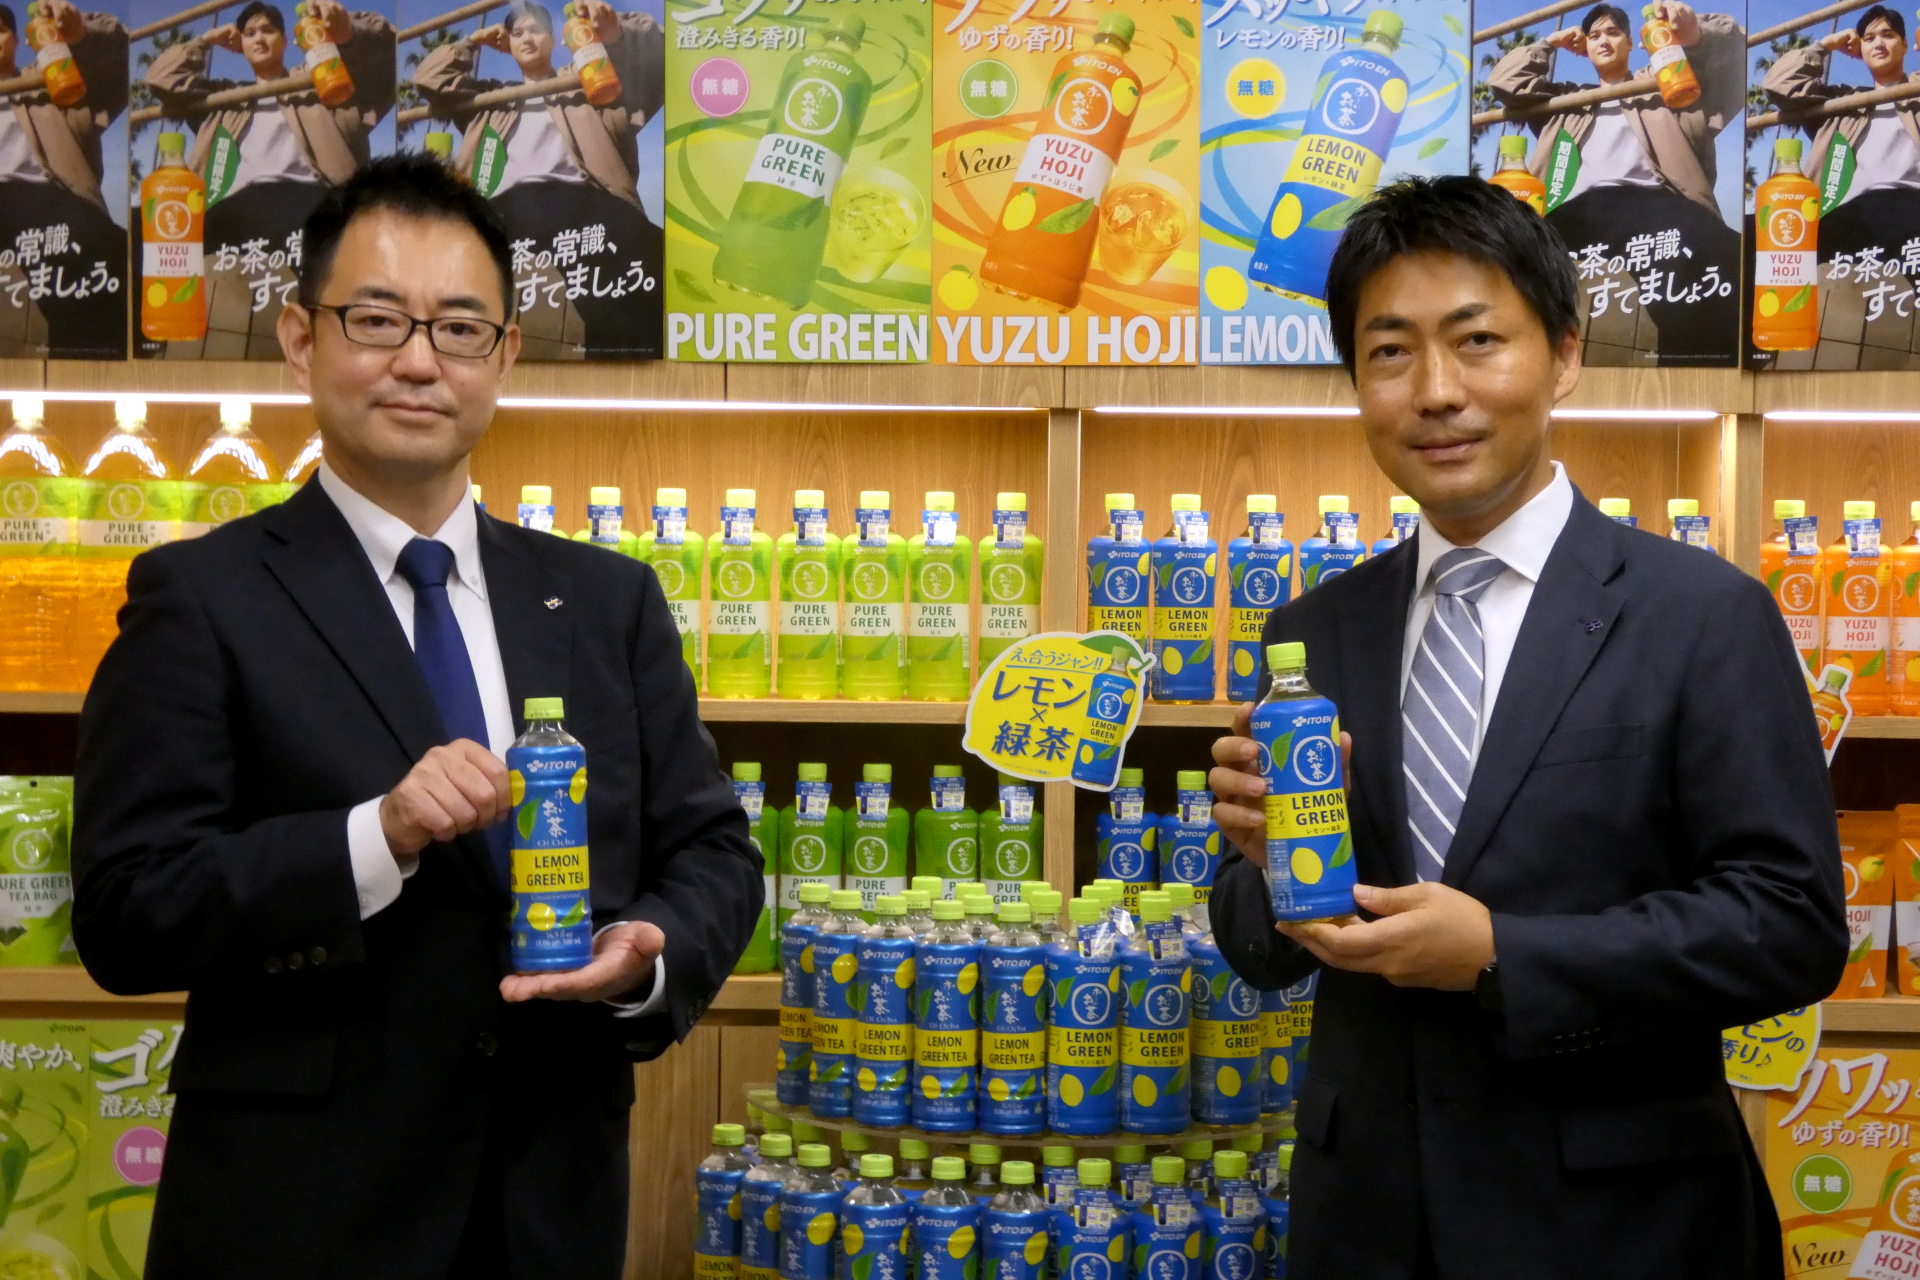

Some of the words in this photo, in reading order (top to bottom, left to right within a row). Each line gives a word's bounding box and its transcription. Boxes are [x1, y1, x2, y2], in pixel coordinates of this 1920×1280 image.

[1216, 24, 1347, 50] レモンの香り!
[701, 78, 739, 97] 無糖
[970, 79, 1008, 98] 無糖
[1237, 80, 1275, 97] 無糖
[772, 138, 826, 167] PURE
[1044, 138, 1095, 165] YUZU
[1306, 138, 1367, 167] LEMON
[942, 147, 1013, 178] New
[761, 155, 826, 187] GREEN
[1039, 156, 1085, 181] HOJI
[1302, 156, 1359, 184] GREEN
[158, 246, 189, 256] YUZU
[1569, 228, 1693, 280] 茶の常識、
[159, 258, 187, 268] HOJI
[1770, 254, 1802, 265] YUZU
[1772, 267, 1800, 277] HOJI
[515, 260, 656, 313] すてましょう。
[1587, 265, 1732, 318] すてましょう。
[1863, 279, 1920, 322] すて
[667, 313, 777, 361] PURE
[788, 313, 928, 361] GREEN
[936, 316, 1070, 363] YUZU
[1087, 316, 1197, 363] HOJI
[1201, 315, 1335, 362] LEMON
[4, 520, 39, 531] PURE
[108, 522, 144, 533] PURE
[0, 530, 44, 541] GREEN
[104, 533, 149, 544] GREEN
[721, 604, 752, 614] PURE
[794, 604, 827, 614] PURE
[854, 606, 887, 616] PURE
[922, 606, 952, 616] PURE
[990, 606, 1023, 617] PURE
[1101, 610, 1142, 619] LEMON
[1168, 610, 1208, 620] LEMON
[716, 616, 756, 626] GREEN
[790, 616, 830, 626] GREEN
[850, 618, 890, 628] GREEN
[918, 618, 956, 628] GREEN
[988, 618, 1027, 629] GREEN
[1102, 622, 1141, 631] GREEN
[1844, 620, 1876, 630] YUZU
[1169, 622, 1208, 632] GREEN
[1793, 630, 1811, 640] OJI
[1846, 632, 1874, 642] HOJI
[992, 670, 1087, 709] レモン
[1091, 720, 1118, 732] LEMON
[991, 719, 1075, 761] 緑茶
[1090, 729, 1115, 740] GREEN
[1292, 792, 1344, 811] LEMON
[1296, 808, 1345, 826] GREEN
[534, 854, 580, 868] LEMON
[526, 874, 566, 886] GREEN
[568, 871, 584, 884] TEA
[856, 880, 886, 890] PURE
[997, 883, 1022, 893] PUR
[864, 1030, 901, 1041] LEMON
[1066, 1032, 1112, 1043] LEMON
[1140, 1032, 1184, 1044] LEMON
[928, 1036, 962, 1047] LEMON
[994, 1038, 1029, 1050] LEMON
[860, 1042, 887, 1055] GREEN
[888, 1045, 907, 1055] TEA
[1068, 1046, 1112, 1057] GREEN
[1140, 1046, 1184, 1057] GREEN
[922, 1050, 950, 1062] GREEN
[951, 1052, 968, 1062] TEA
[989, 1053, 1018, 1064] GREEN
[1019, 1054, 1035, 1064] TEA
[1791, 1120, 1912, 1149] ゆずの香り!
[1802, 1174, 1843, 1193] 無糖
[1873, 1252, 1919, 1280] HOJI
